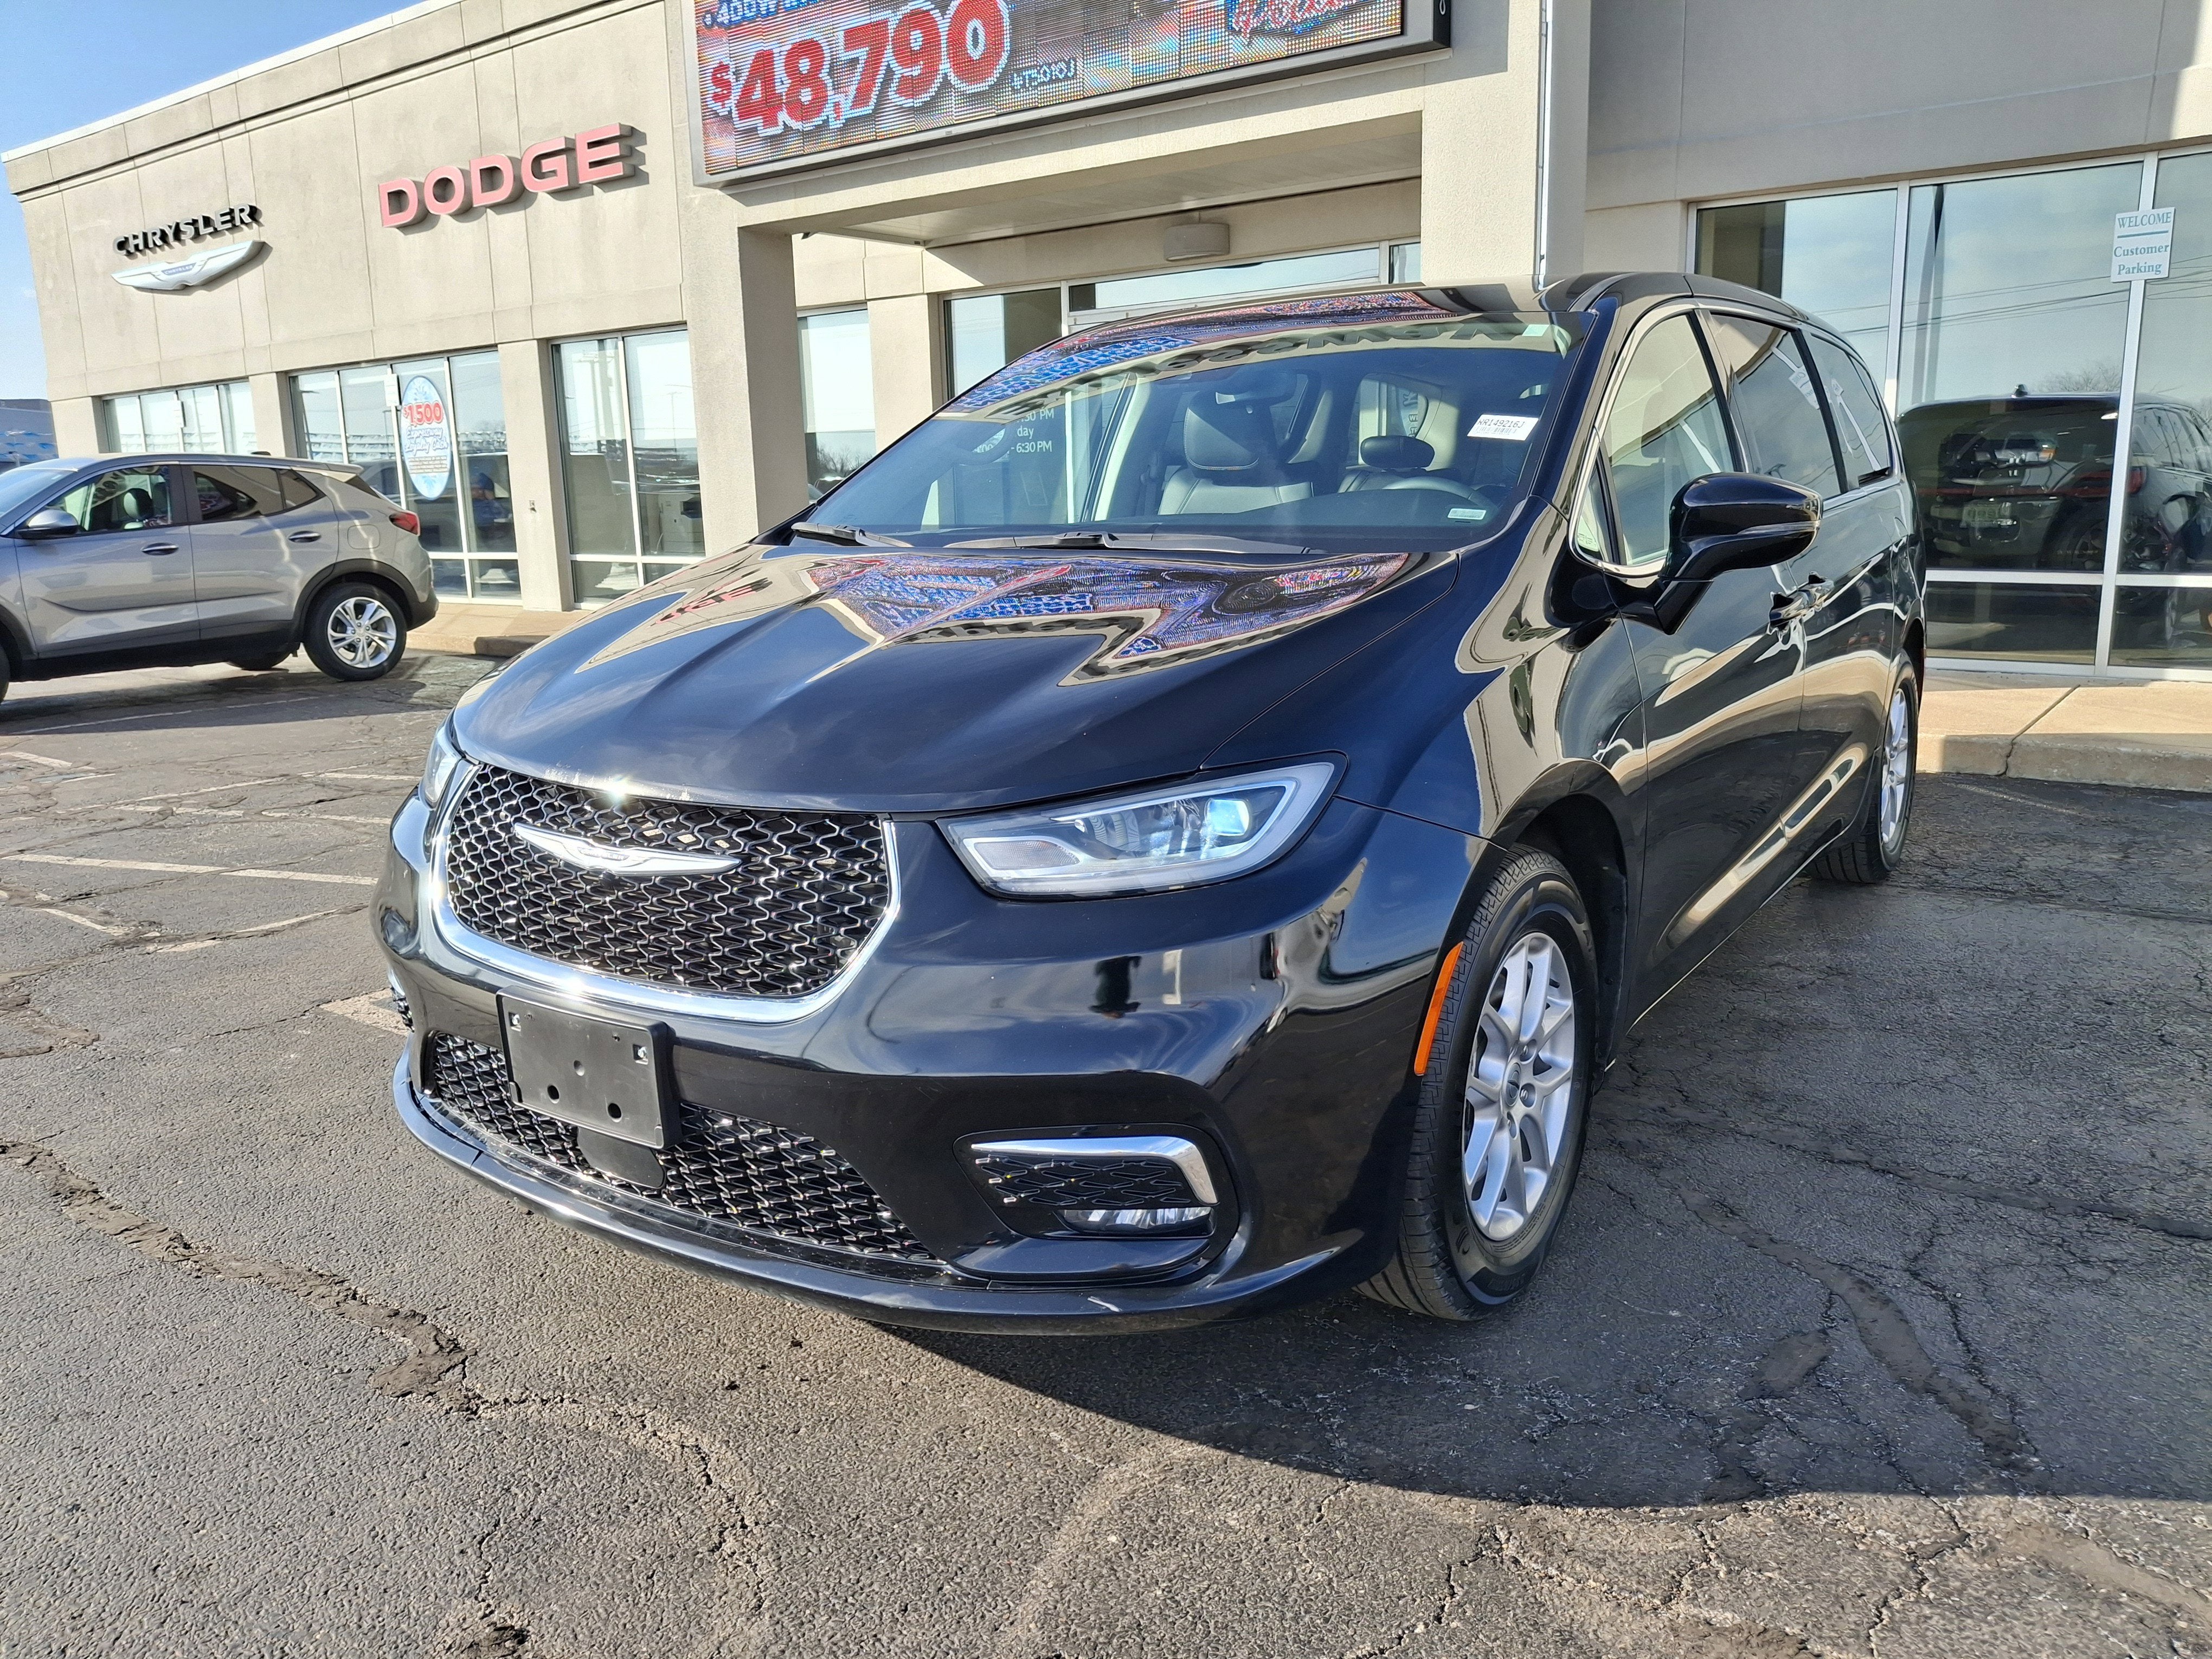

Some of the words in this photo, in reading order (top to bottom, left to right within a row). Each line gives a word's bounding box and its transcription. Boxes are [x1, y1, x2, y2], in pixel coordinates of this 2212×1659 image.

[708, 0, 1006, 133] $48,790
[377, 121, 636, 228] DODGE
[2117, 211, 2172, 229] WELCOME
[113, 203, 254, 256] CHRYSLER
[2114, 244, 2170, 258] Customer
[2117, 261, 2162, 275] Parking
[403, 400, 444, 427] $1,500
[1039, 408, 1054, 420] PM
[1015, 442, 1036, 453] 6:30
[1037, 440, 1052, 453] PM
